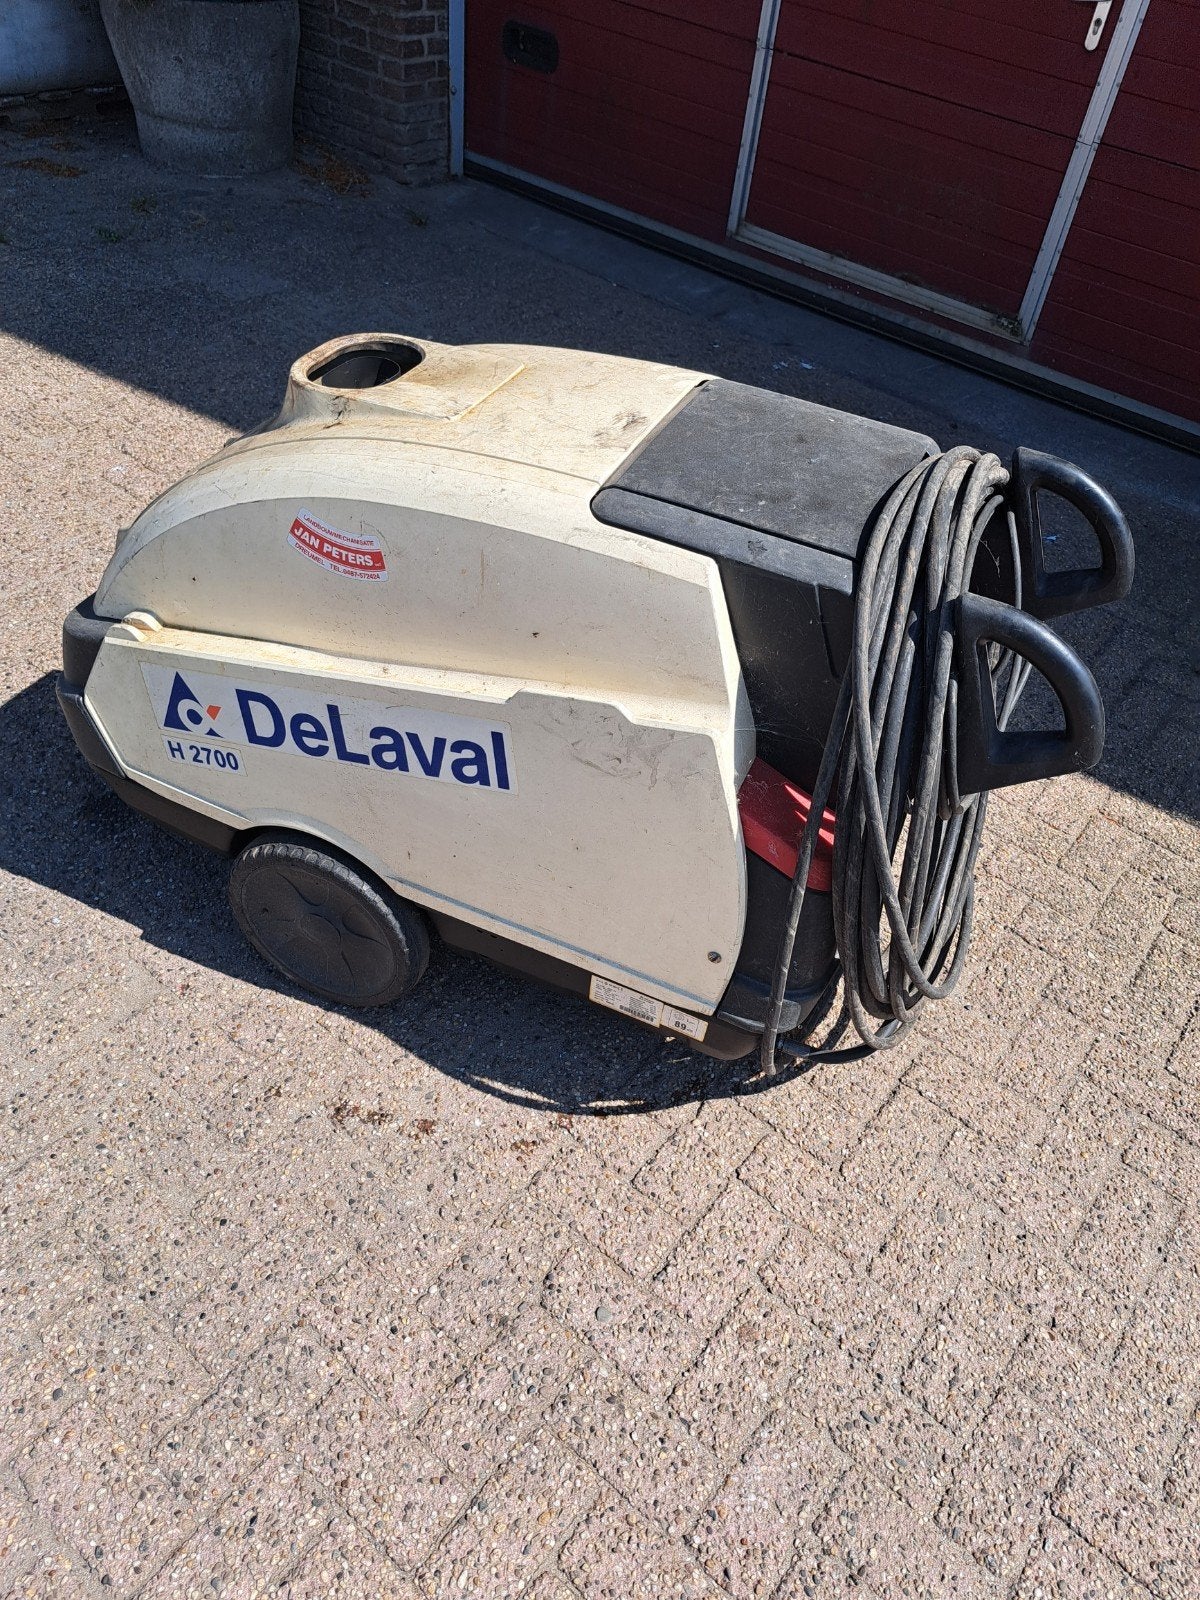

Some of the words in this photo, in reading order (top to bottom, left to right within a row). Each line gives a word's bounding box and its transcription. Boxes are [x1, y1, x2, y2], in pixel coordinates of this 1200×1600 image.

[294, 527, 320, 549] JAN
[323, 543, 373, 567] PETERS
[294, 542, 325, 566] DREUMEL
[235, 688, 510, 790] DeLaval
[167, 740, 184, 760] H
[189, 746, 239, 771] 2700
[674, 1020, 687, 1030] 89
